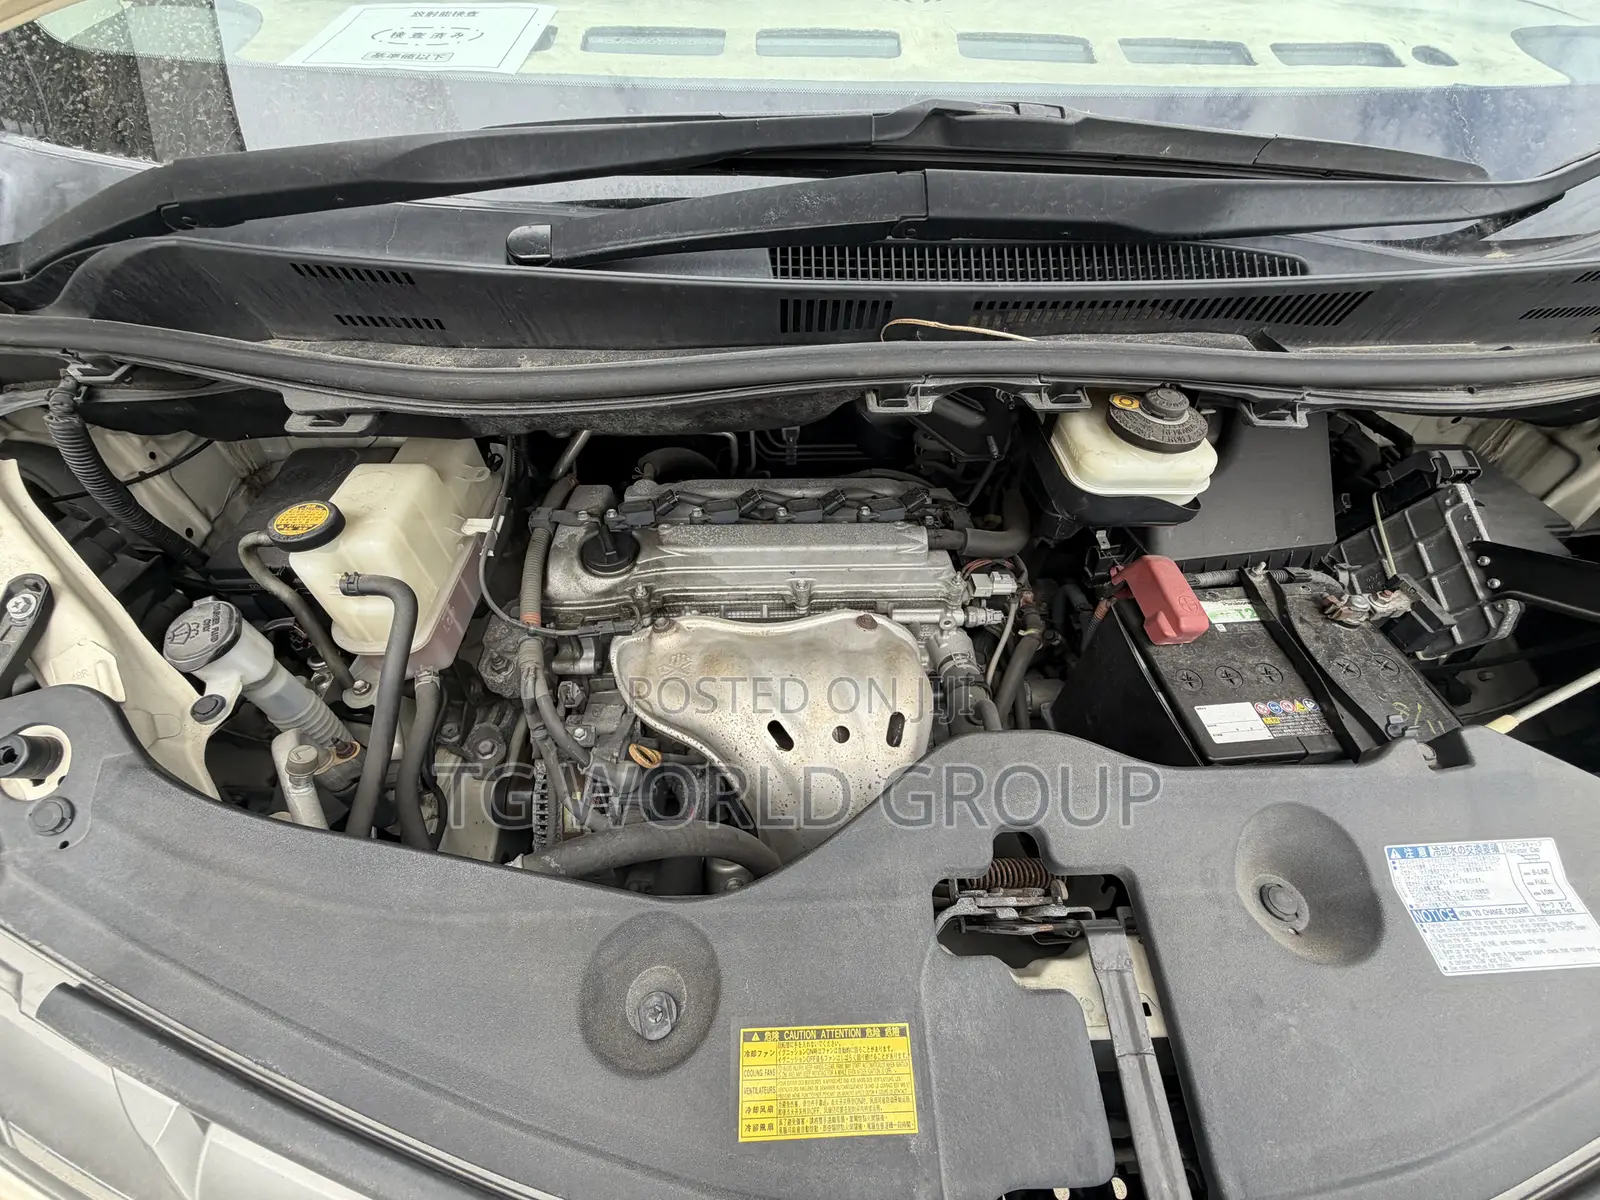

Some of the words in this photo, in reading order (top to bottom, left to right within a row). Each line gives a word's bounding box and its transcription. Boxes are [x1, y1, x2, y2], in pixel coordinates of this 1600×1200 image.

[389, 31, 465, 39] 検査済み
[1404, 847, 1429, 857] 注意
[1412, 908, 1457, 923] NOTICE
[1458, 910, 1470, 918] HOW
[1471, 909, 1480, 917] TO
[1483, 908, 1503, 916] CHANGE
[1504, 906, 1530, 915] COOLANT
[784, 1030, 816, 1040] CAUTION
[820, 1028, 861, 1039] ATTENTION
[764, 1068, 776, 1076] FANS
[744, 1086, 776, 1095] VENTILATEURS
